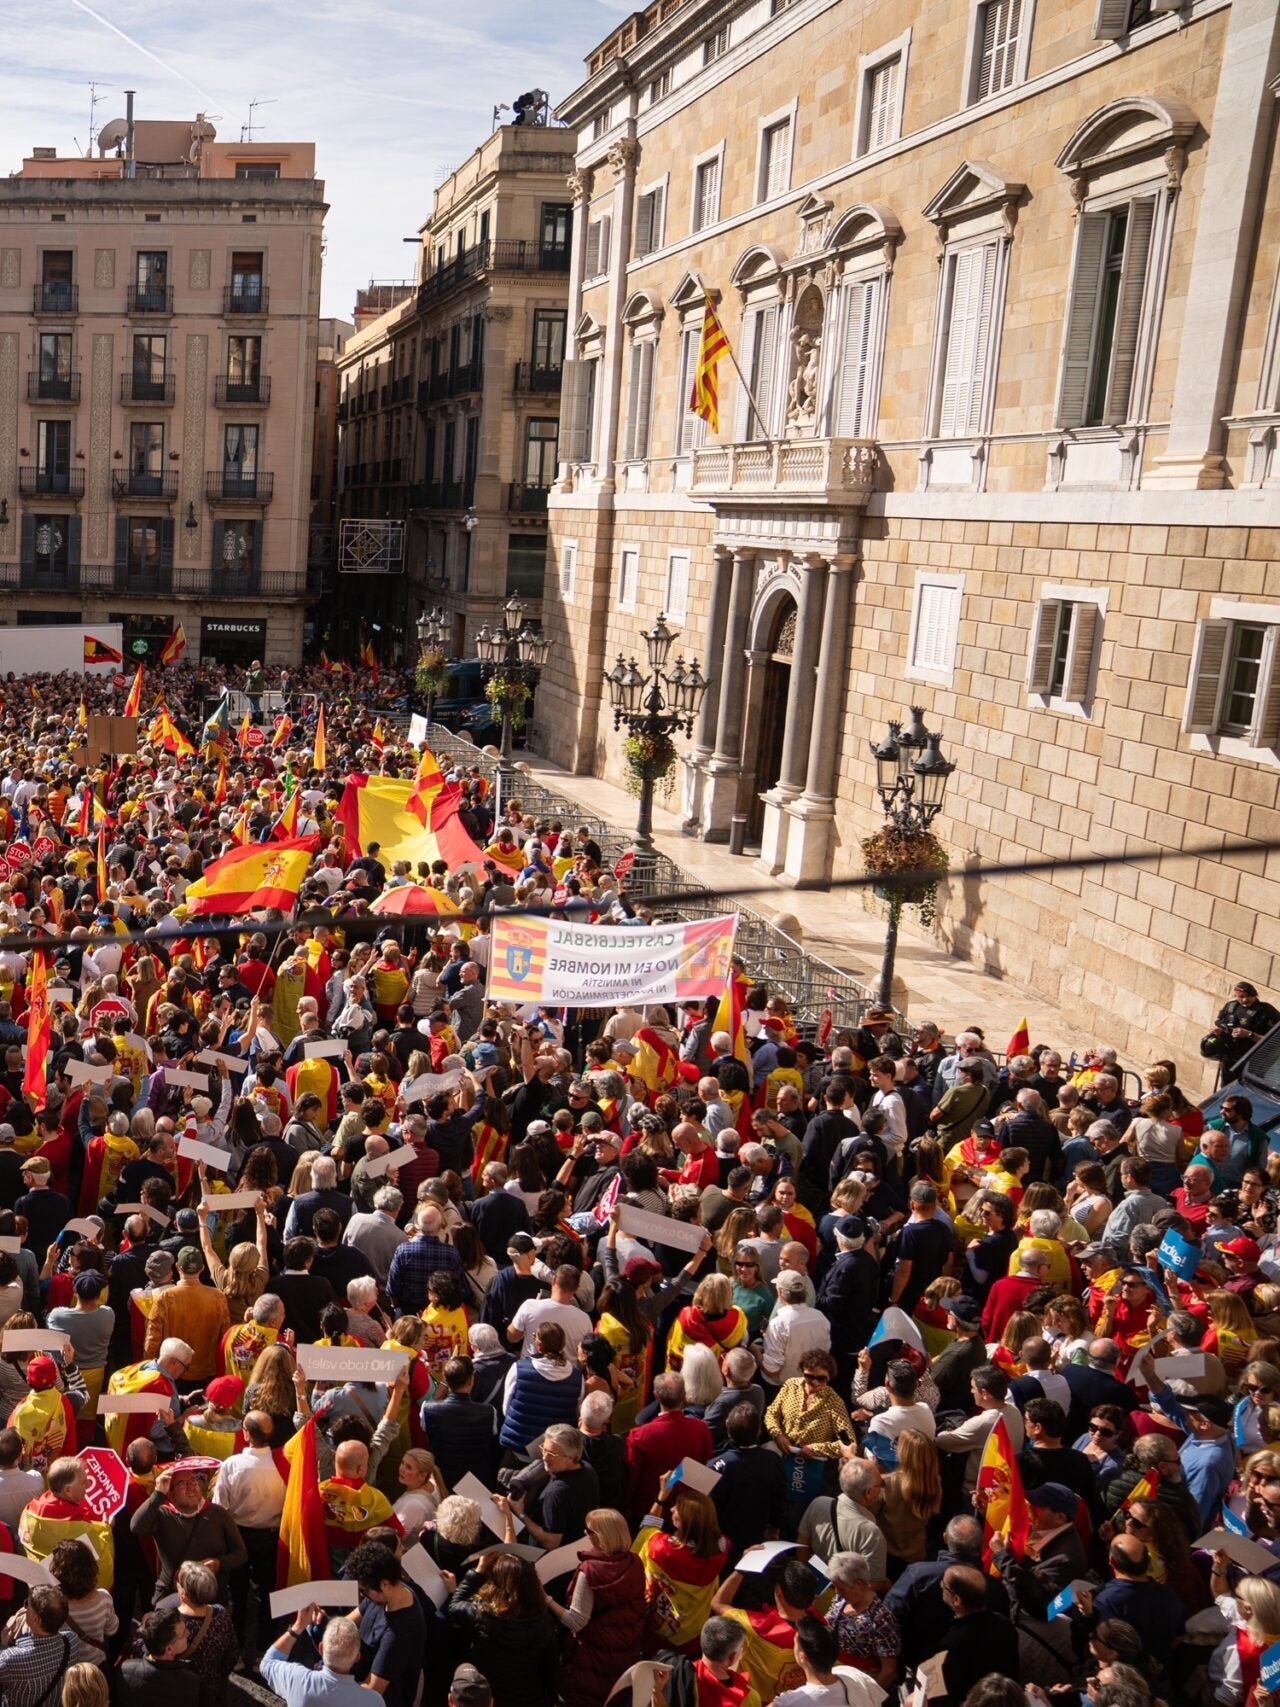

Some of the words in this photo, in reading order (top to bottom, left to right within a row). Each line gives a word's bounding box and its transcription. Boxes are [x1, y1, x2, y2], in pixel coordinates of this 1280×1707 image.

[207, 623, 260, 633] STARBUCKS
[9, 847, 30, 860] STOP
[86, 1454, 120, 1502] SÁNCHEZ
[83, 1471, 111, 1516] STO
